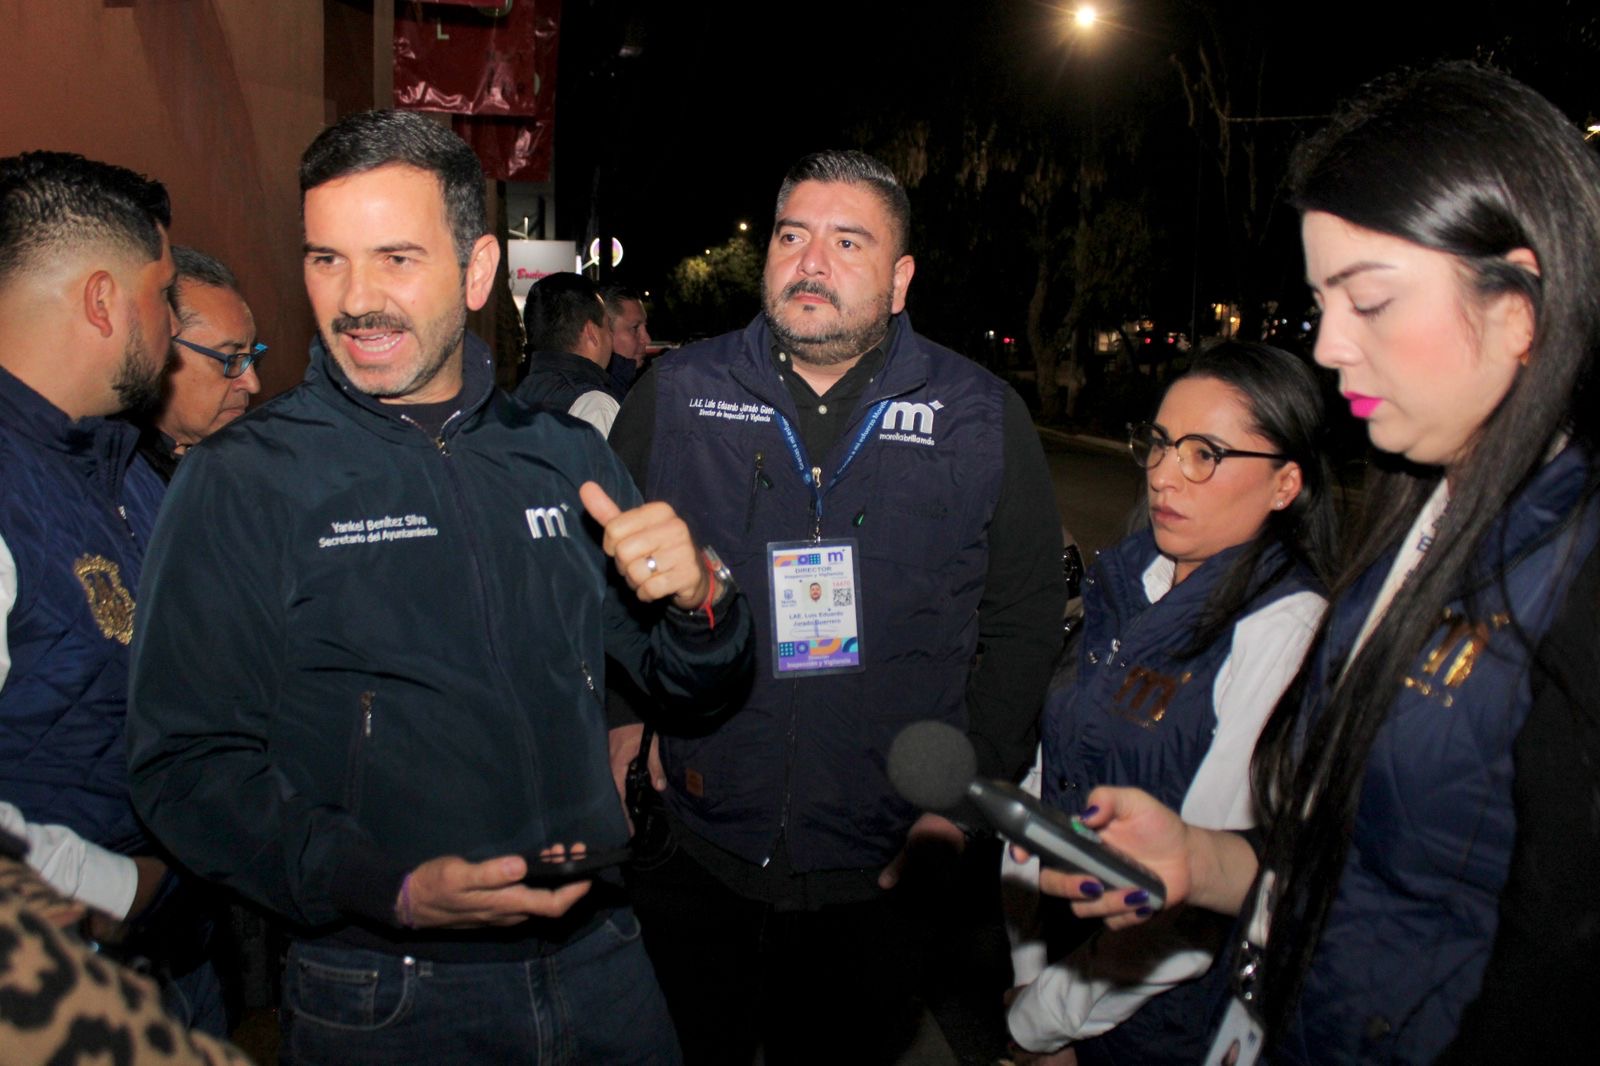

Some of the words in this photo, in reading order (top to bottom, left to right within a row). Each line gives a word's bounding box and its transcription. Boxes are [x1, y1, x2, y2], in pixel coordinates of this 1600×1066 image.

[704, 398, 716, 409] Luis
[717, 400, 739, 412] Eduardo
[740, 403, 759, 414] Jurado
[699, 408, 716, 417] Director
[716, 410, 722, 418] de
[745, 414, 749, 422] y
[750, 413, 771, 423] Vigilancia
[331, 516, 366, 534] Yankel
[404, 514, 428, 528] Silva
[319, 530, 366, 548] Secretario
[366, 530, 381, 544] del
[382, 526, 439, 543] Ayuntamiento
